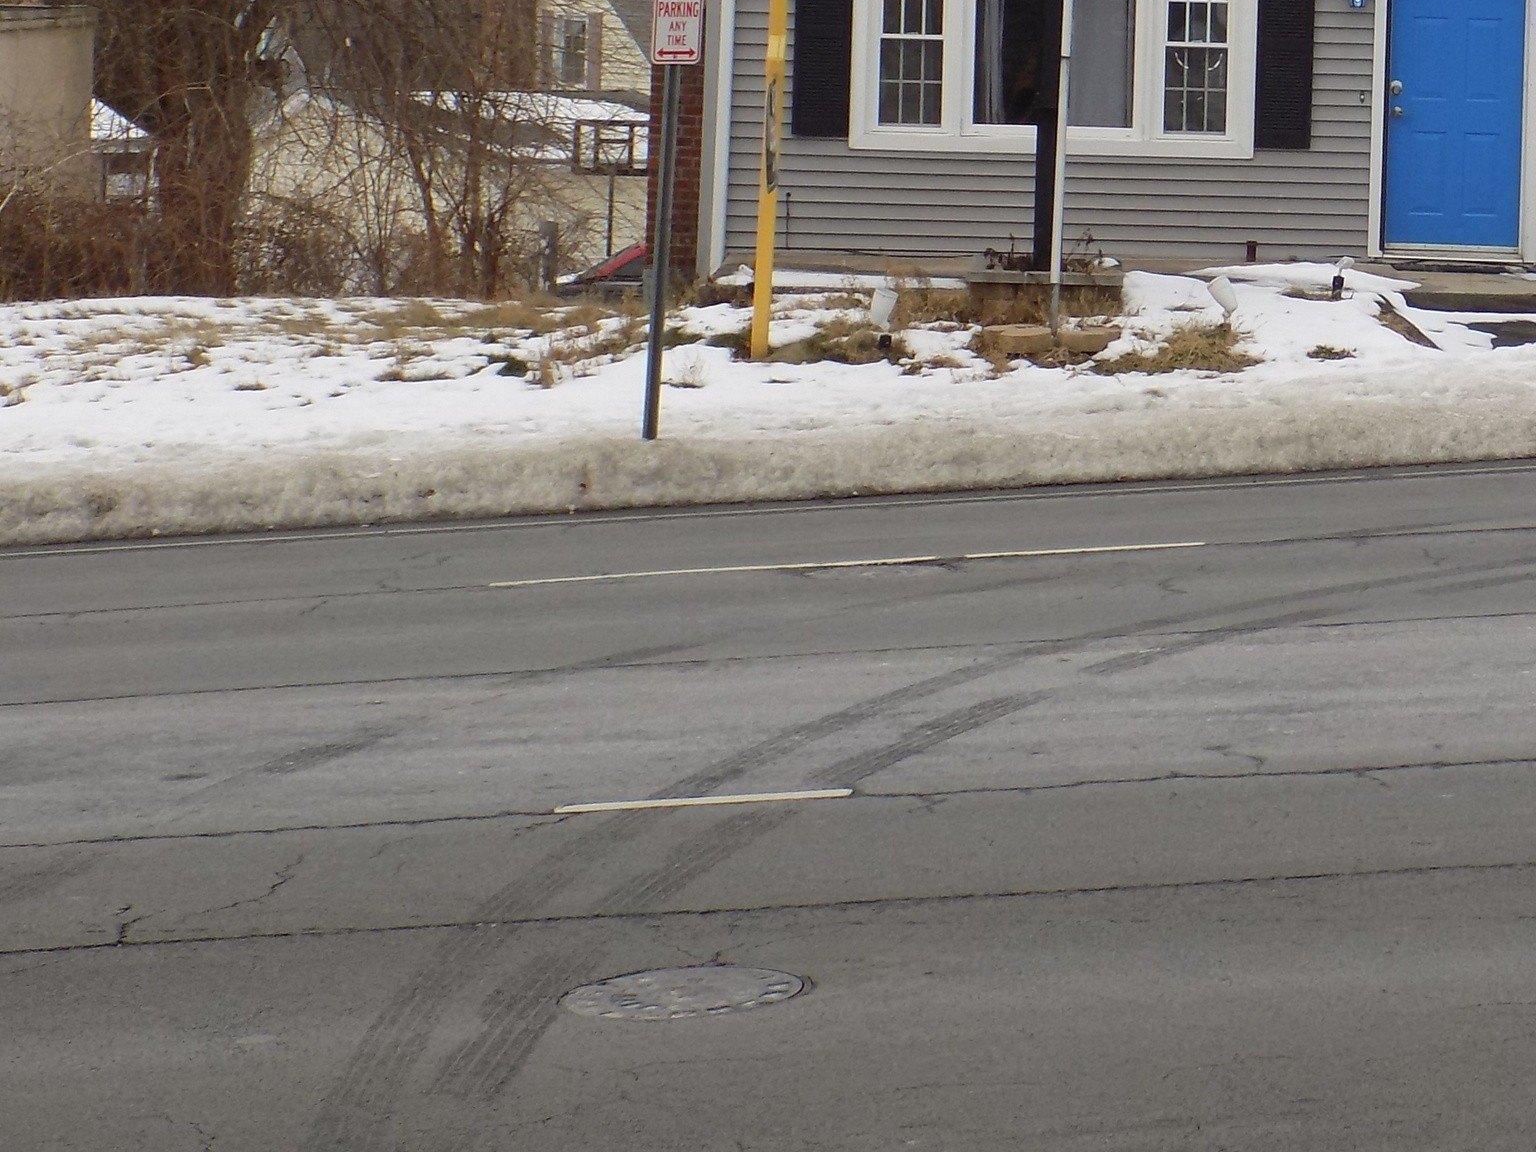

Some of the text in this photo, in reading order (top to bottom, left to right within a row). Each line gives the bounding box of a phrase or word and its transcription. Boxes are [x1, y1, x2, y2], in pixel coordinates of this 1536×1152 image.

[658, 1, 700, 18] PARKING
[668, 21, 687, 32] ANY
[667, 34, 687, 46] TIME
